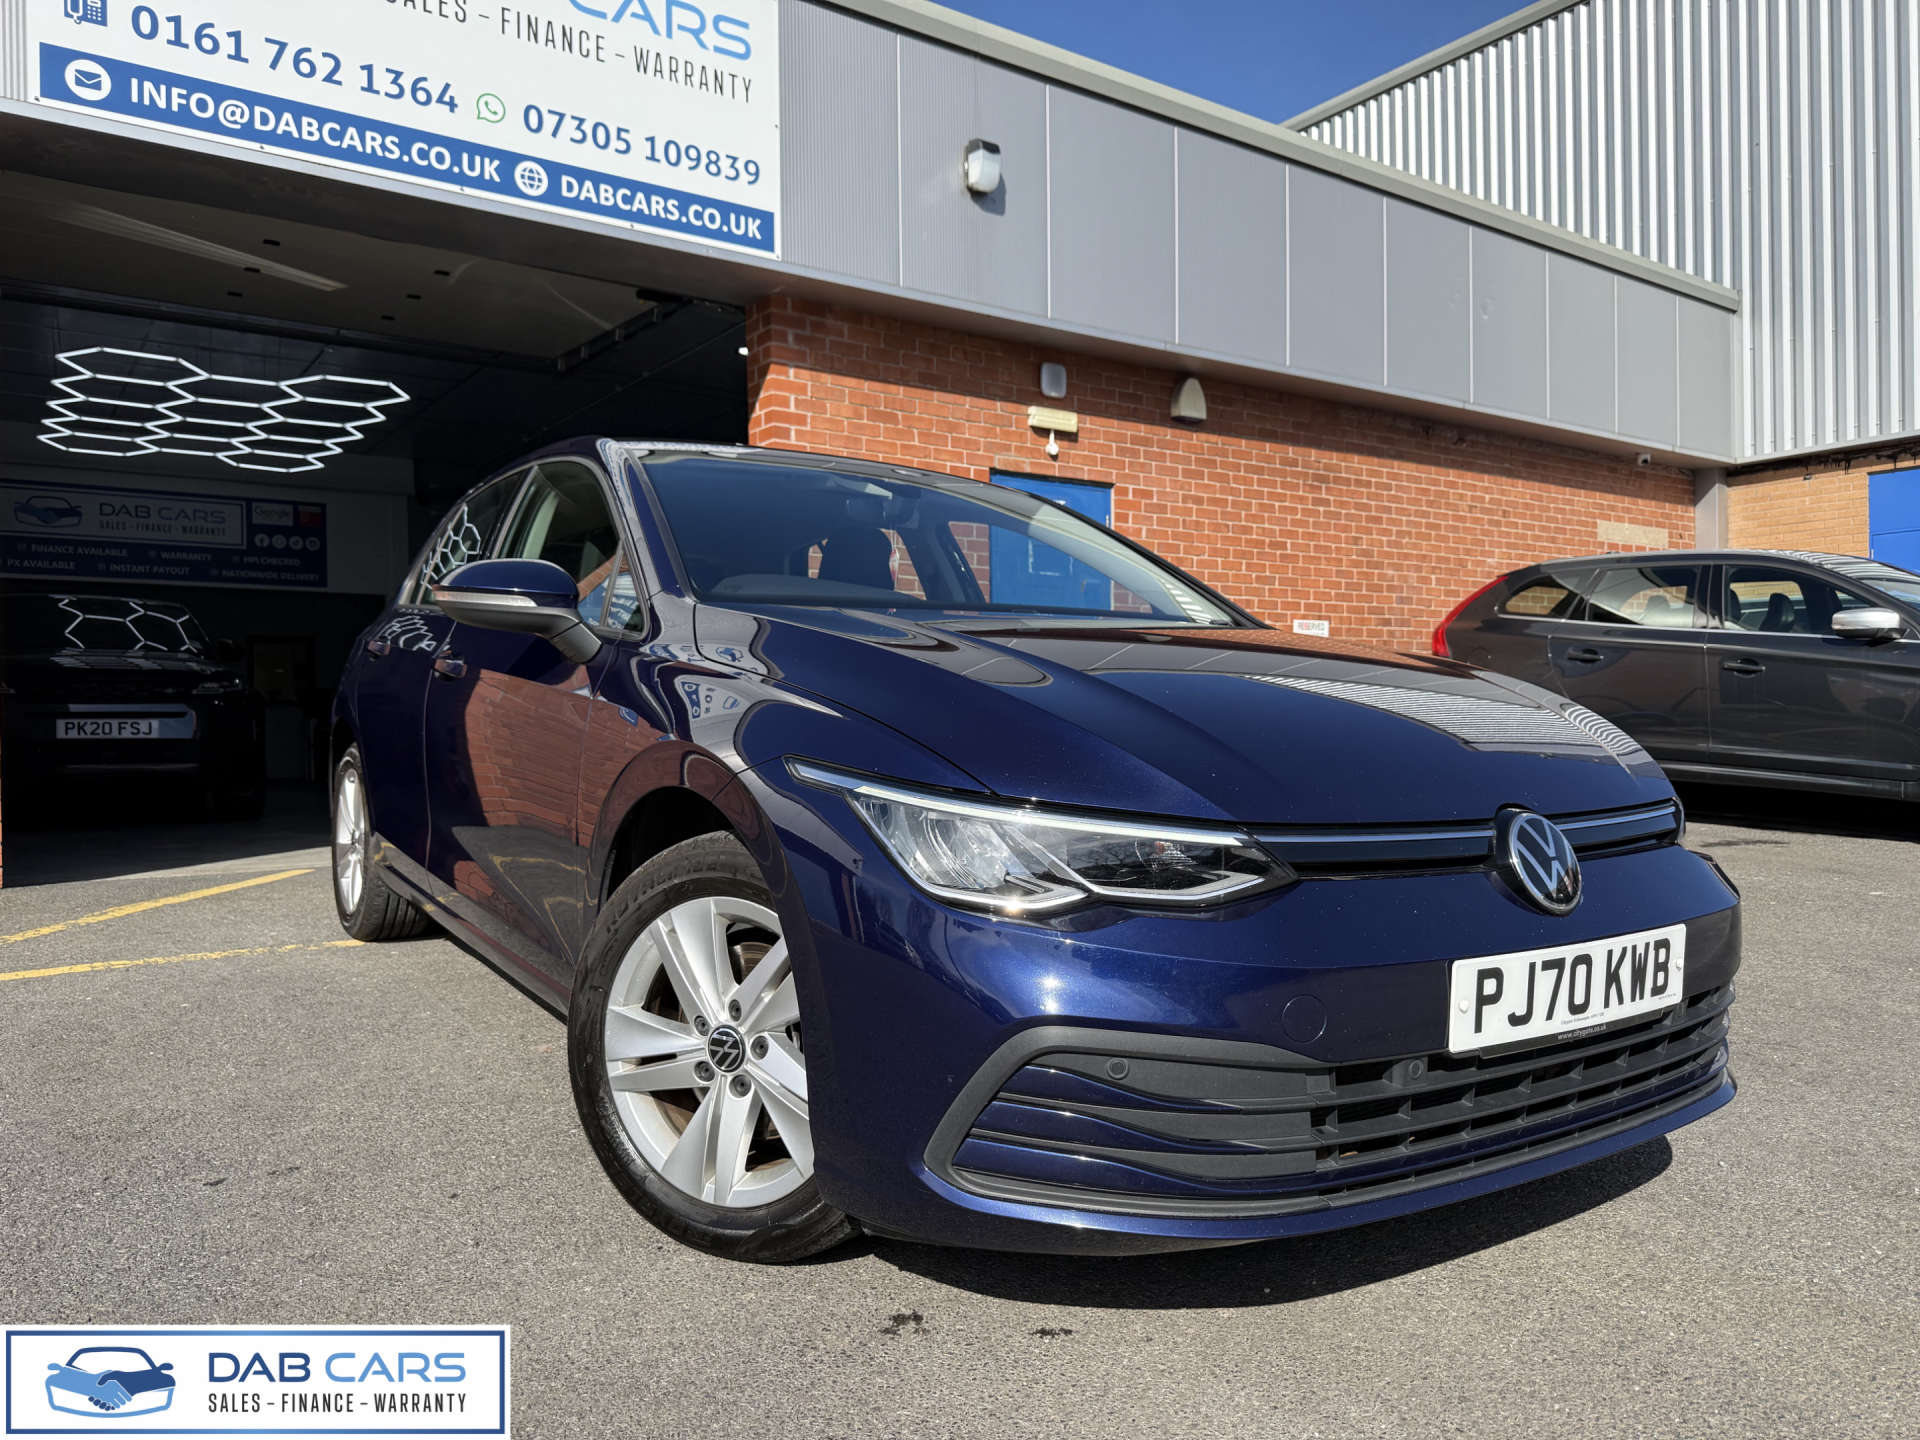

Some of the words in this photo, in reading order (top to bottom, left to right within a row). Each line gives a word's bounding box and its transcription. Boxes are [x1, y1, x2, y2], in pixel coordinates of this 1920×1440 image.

[130, 5, 250, 64] 0161
[264, 37, 344, 86] 762
[359, 63, 459, 113] 1364
[500, 7, 606, 63] FINANCE
[633, 45, 752, 103] WARRANTY
[130, 77, 501, 183] INFO@DABCARS.CO.UK
[523, 104, 632, 155] 07305
[644, 135, 761, 185] 109839
[560, 174, 762, 240] DABCARS.CO.UK
[98, 502, 151, 519] DAB
[158, 506, 227, 524] CARS
[23, 559, 76, 569] AVAILABLE
[31, 543, 73, 553] FINANCE
[77, 546, 128, 557] AVAILABLE
[109, 562, 150, 574] INSTANT
[152, 565, 191, 576] PAYOUT
[160, 551, 212, 561] WARRANTY
[64, 720, 113, 737] PK20
[118, 720, 153, 737] FSJ
[1474, 953, 1593, 1034] PJ70
[1604, 938, 1671, 1009] KWB
